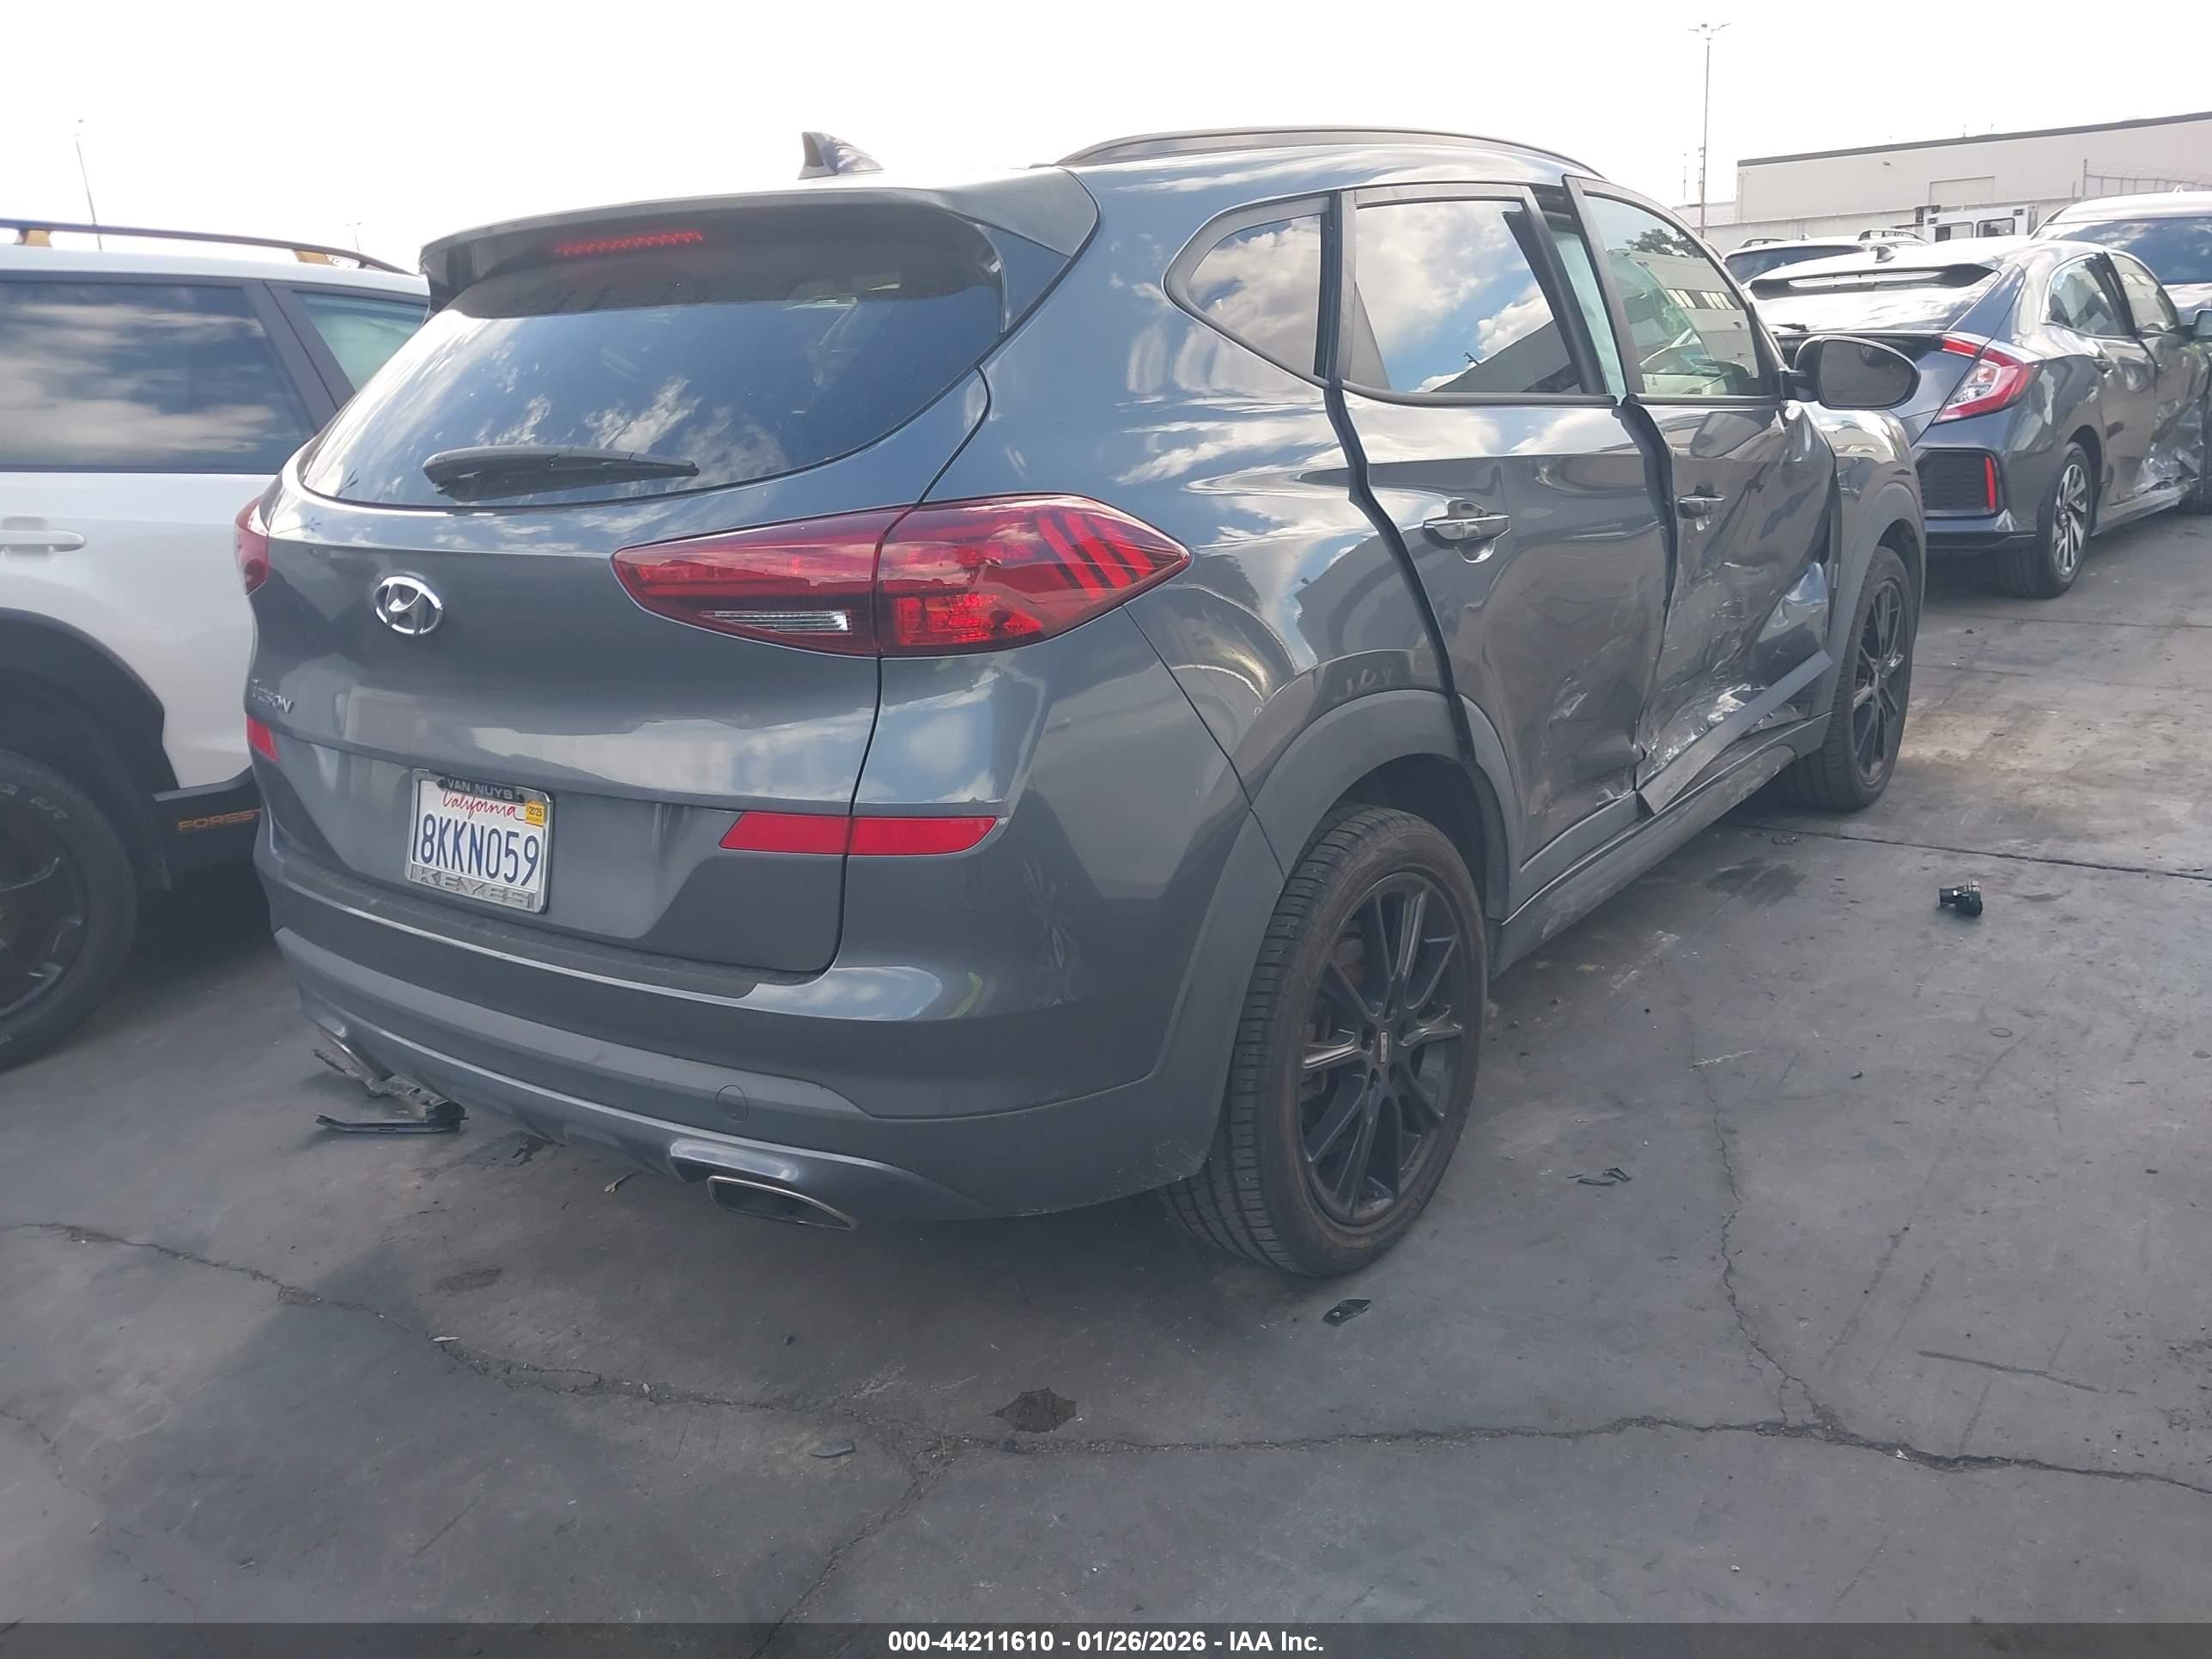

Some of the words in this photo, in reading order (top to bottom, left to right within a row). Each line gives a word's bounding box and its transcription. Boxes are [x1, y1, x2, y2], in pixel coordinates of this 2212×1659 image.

[442, 790, 525, 820] California
[447, 778, 471, 792] VAN
[474, 783, 514, 800] NUYS
[421, 813, 539, 886] 8KKN059
[420, 866, 531, 908] KEYES
